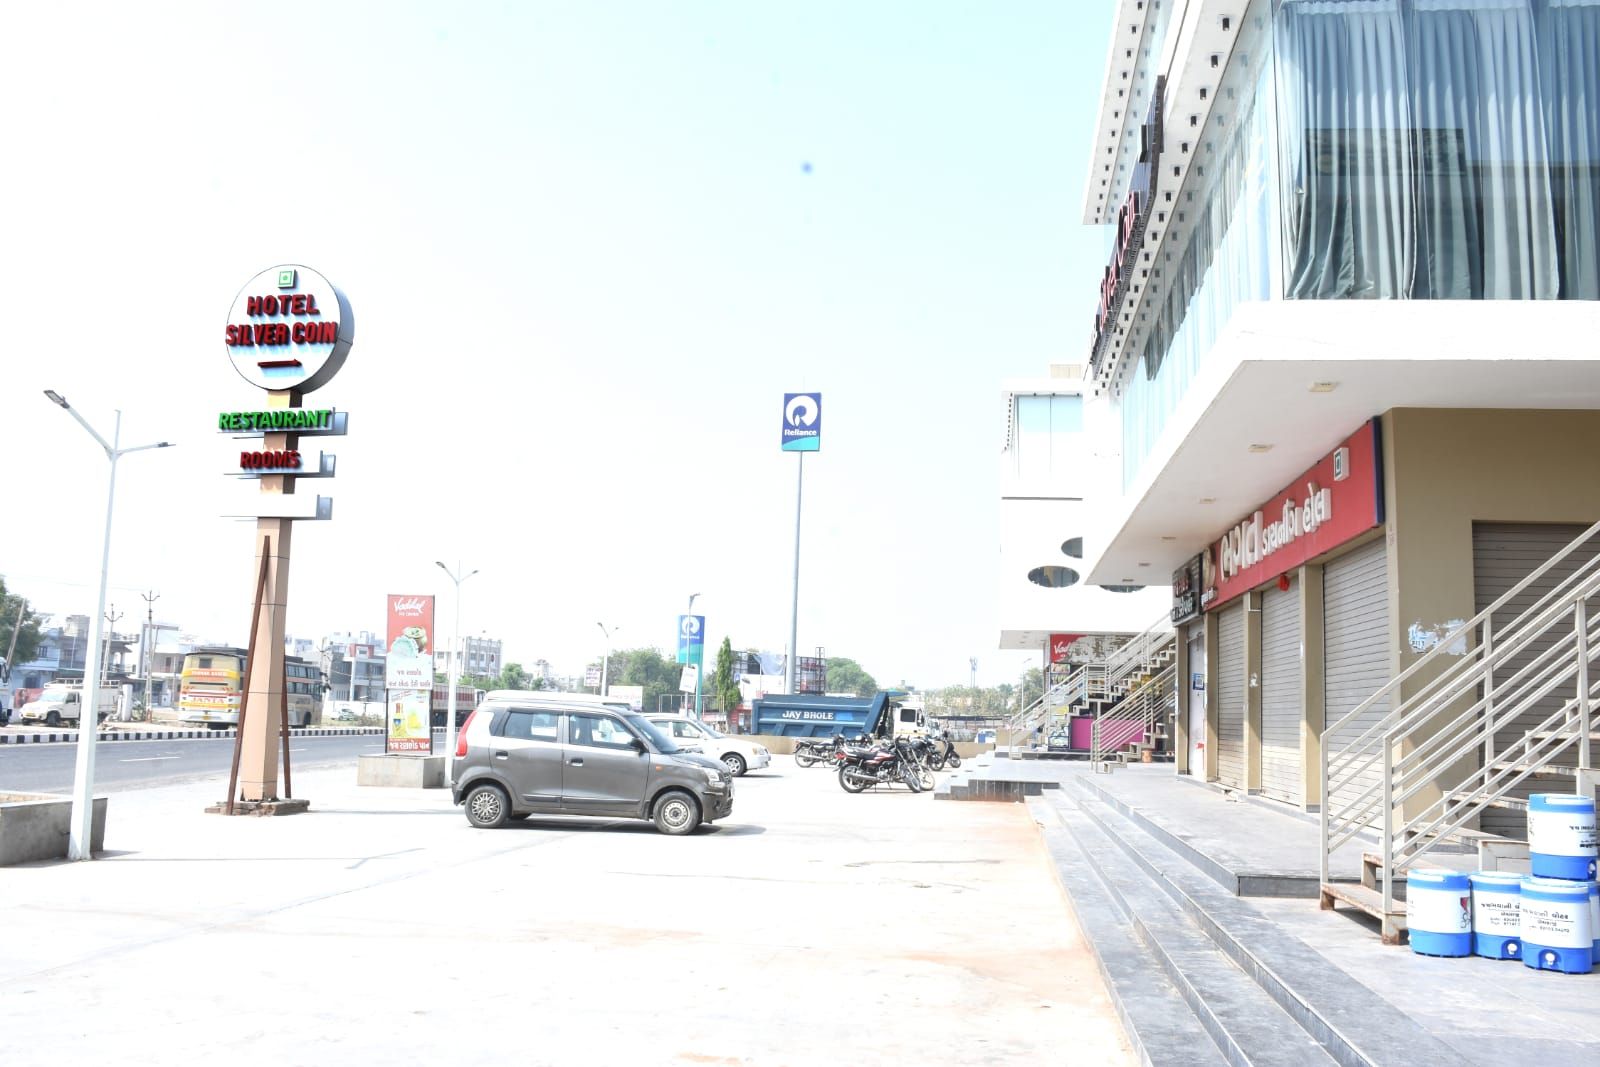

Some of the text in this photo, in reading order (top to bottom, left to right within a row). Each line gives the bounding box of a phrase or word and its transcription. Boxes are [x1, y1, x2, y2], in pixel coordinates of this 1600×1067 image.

[247, 294, 321, 317] HOTEL
[225, 321, 338, 347] SILVER COIN
[218, 409, 332, 431] RESTAURANT
[784, 428, 817, 436] Reliance
[240, 450, 302, 470] ROOMS
[782, 710, 834, 720] JAY BHOLE
